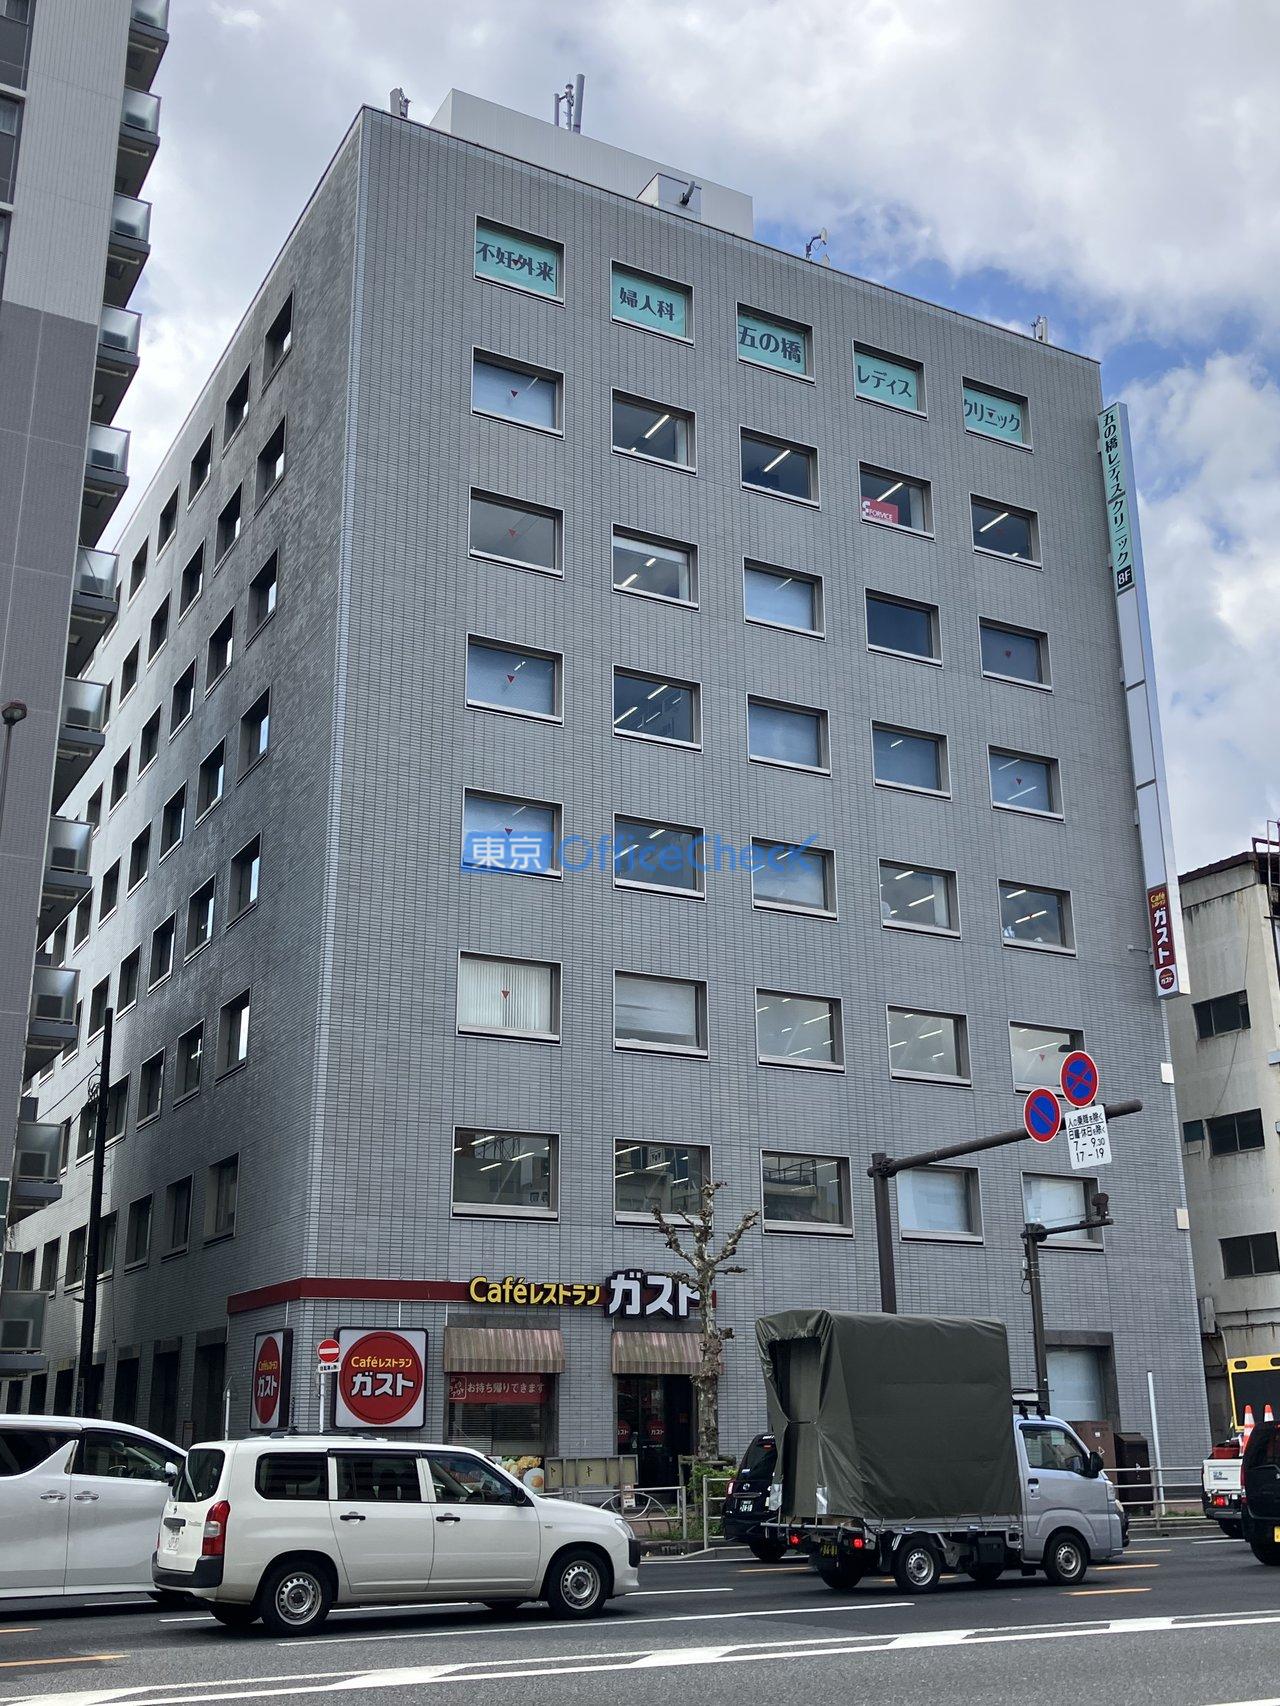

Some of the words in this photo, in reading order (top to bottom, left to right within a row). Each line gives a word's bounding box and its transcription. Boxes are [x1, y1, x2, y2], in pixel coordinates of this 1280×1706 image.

[619, 287, 676, 321] 婦人科
[738, 324, 802, 364] 五の橋
[857, 364, 912, 398] レディス
[963, 398, 1021, 432] クリニック
[1103, 410, 1129, 567] 五の橋レディスクリニック
[1117, 569, 1131, 586] 8F
[1153, 907, 1170, 964] ガスト
[469, 1276, 601, 1306] Caféレストラン
[608, 1271, 701, 1316] ガスト
[350, 1356, 413, 1368] Caféレストラン
[257, 1375, 278, 1398] ガスト
[351, 1371, 414, 1397] ガスト
[467, 1382, 545, 1394] お持ち帰りできます
